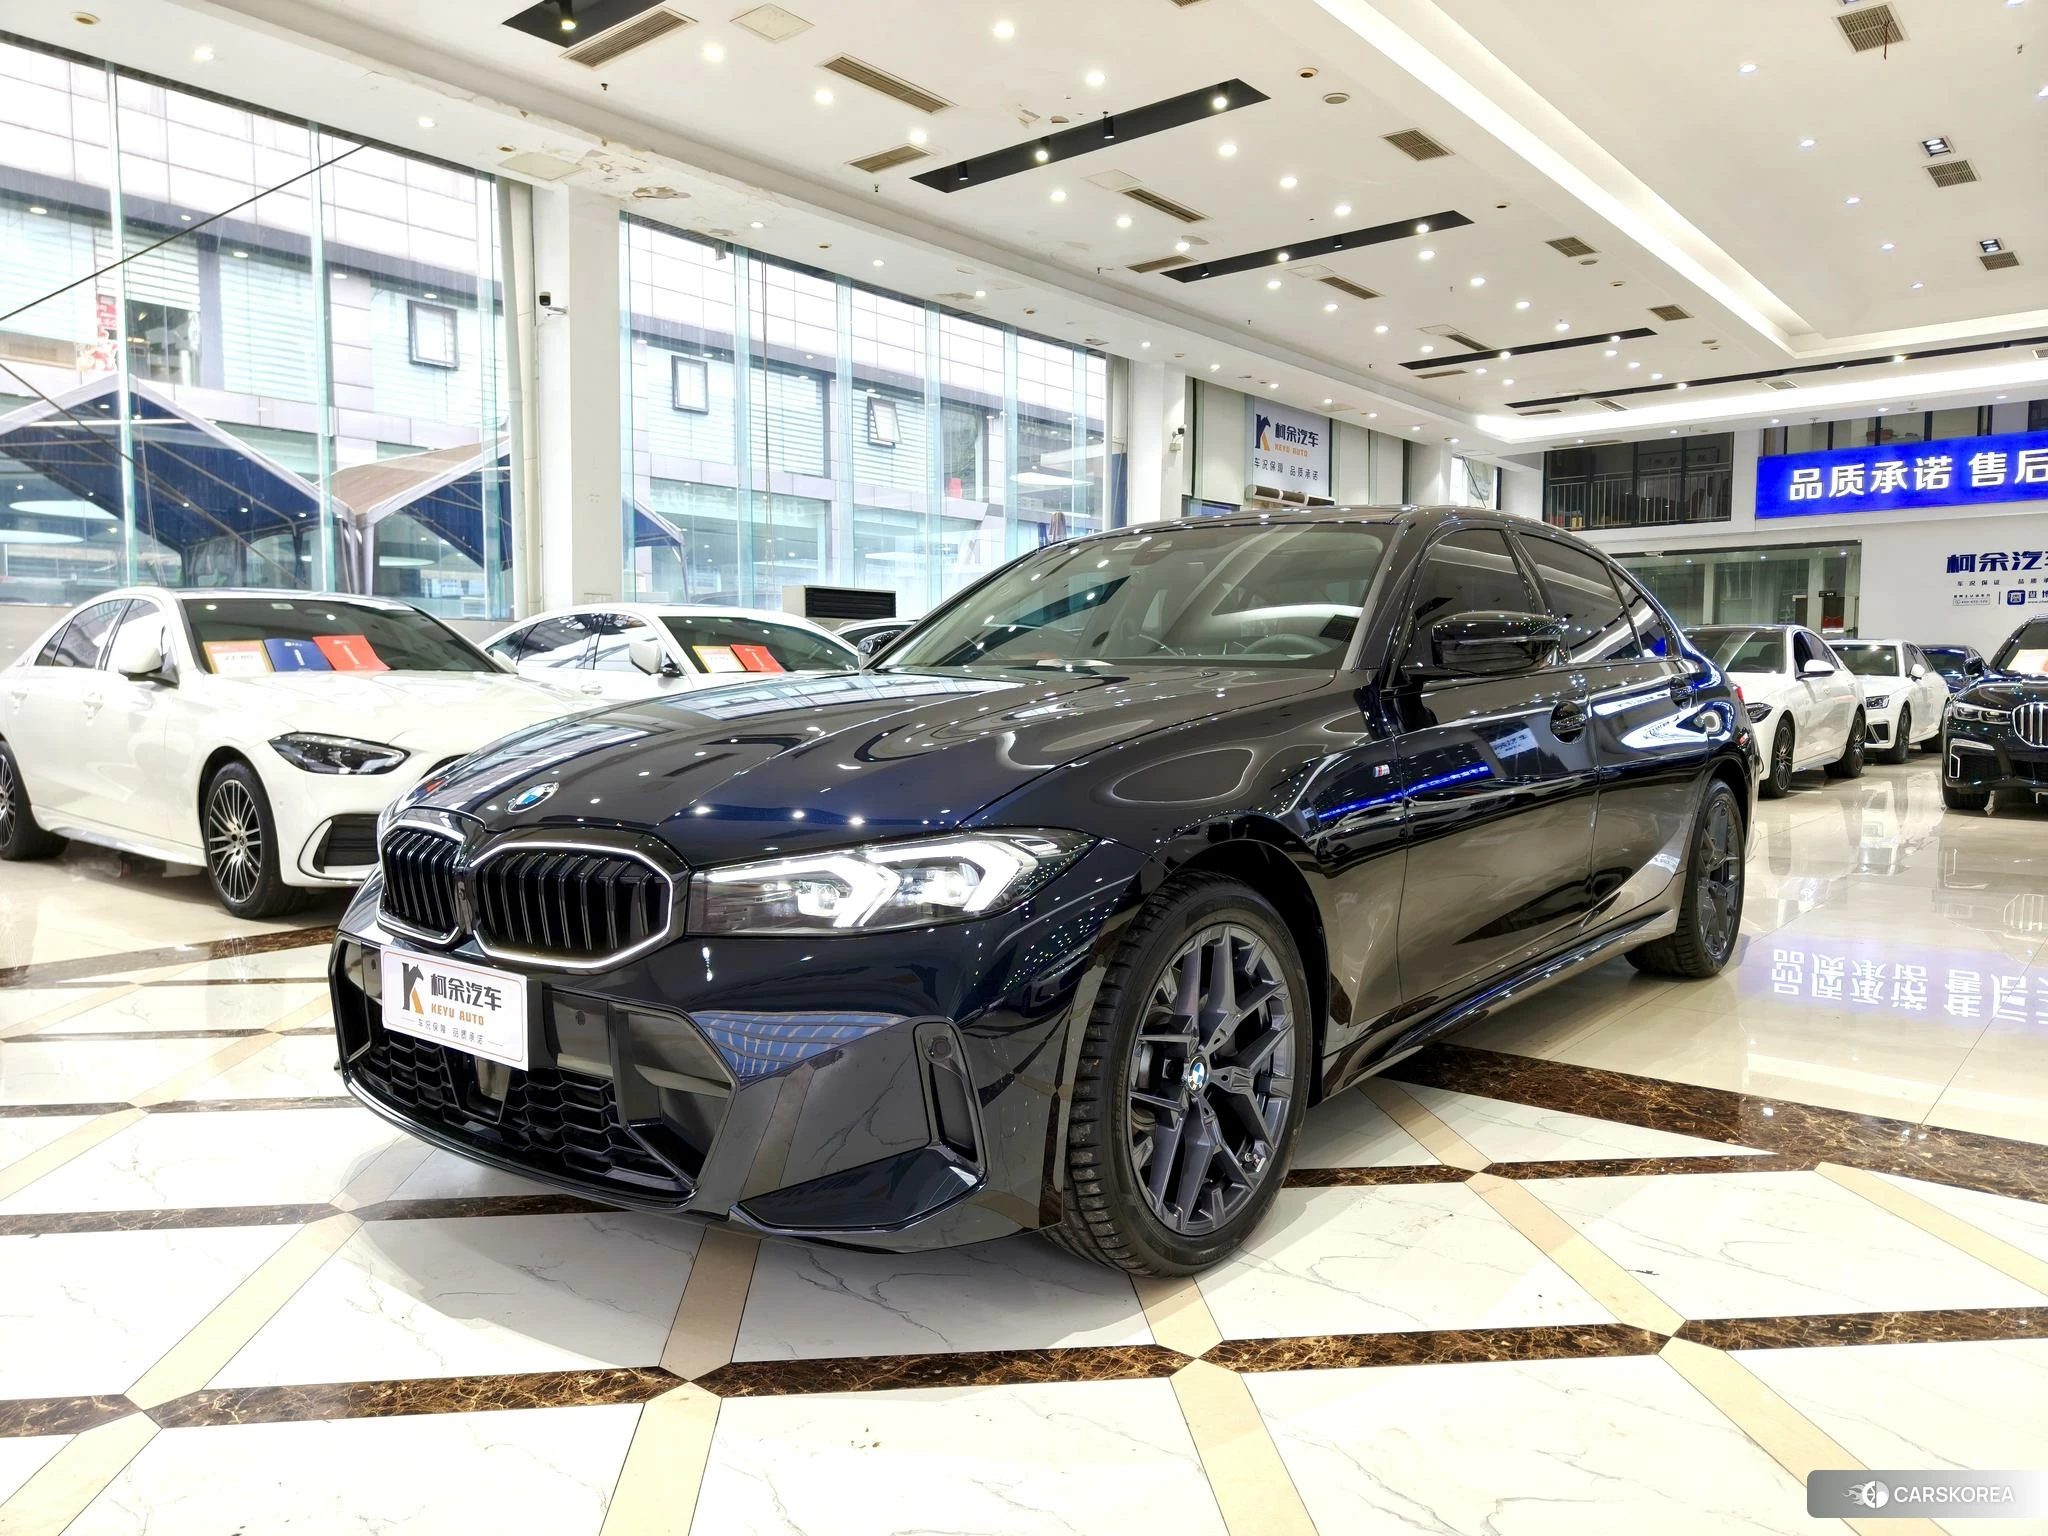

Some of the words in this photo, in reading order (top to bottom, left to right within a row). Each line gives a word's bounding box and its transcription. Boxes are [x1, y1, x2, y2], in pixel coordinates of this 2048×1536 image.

[1275, 422, 1319, 447] 柯余汽车
[1789, 455, 1953, 501] 品质承诺
[1968, 448, 2048, 488] 售后
[1946, 550, 2048, 574] 柯余汽
[430, 973, 502, 1011] 柯余汽车
[431, 1003, 455, 1018] KEYU
[459, 1010, 484, 1026] AUTO
